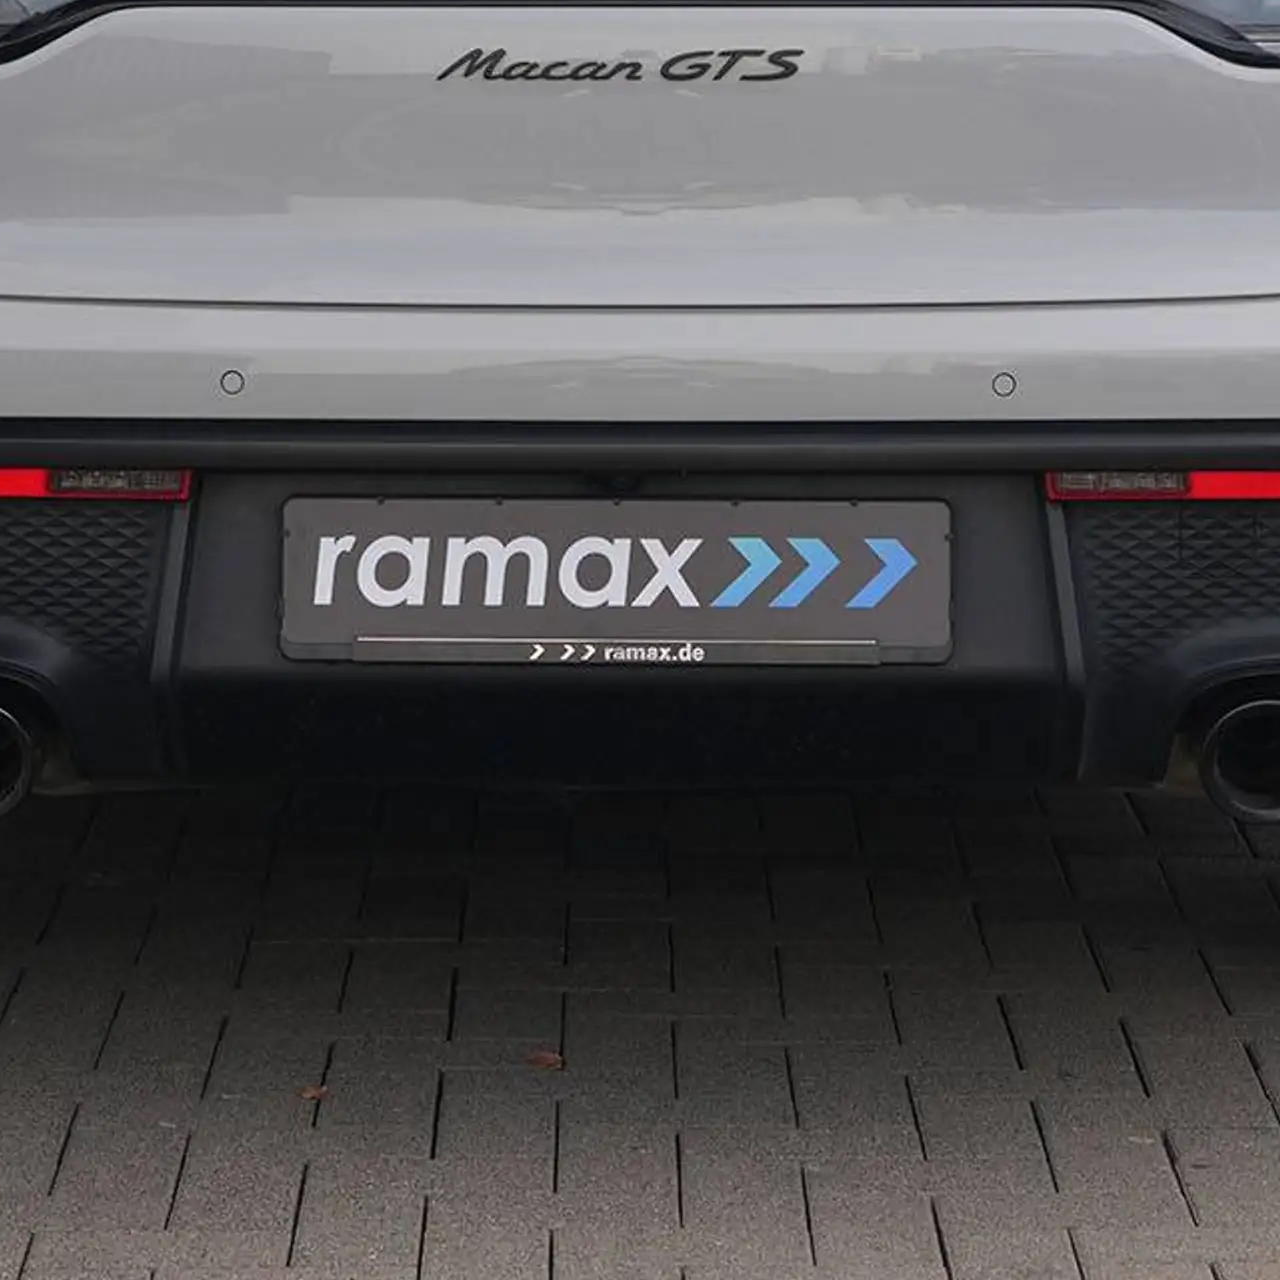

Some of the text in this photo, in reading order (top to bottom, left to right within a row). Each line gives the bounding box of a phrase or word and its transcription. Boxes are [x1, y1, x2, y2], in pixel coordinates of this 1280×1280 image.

[436, 48, 805, 81] Macan GTS
[312, 535, 704, 608] ramax
[604, 642, 705, 662] ramax.de
